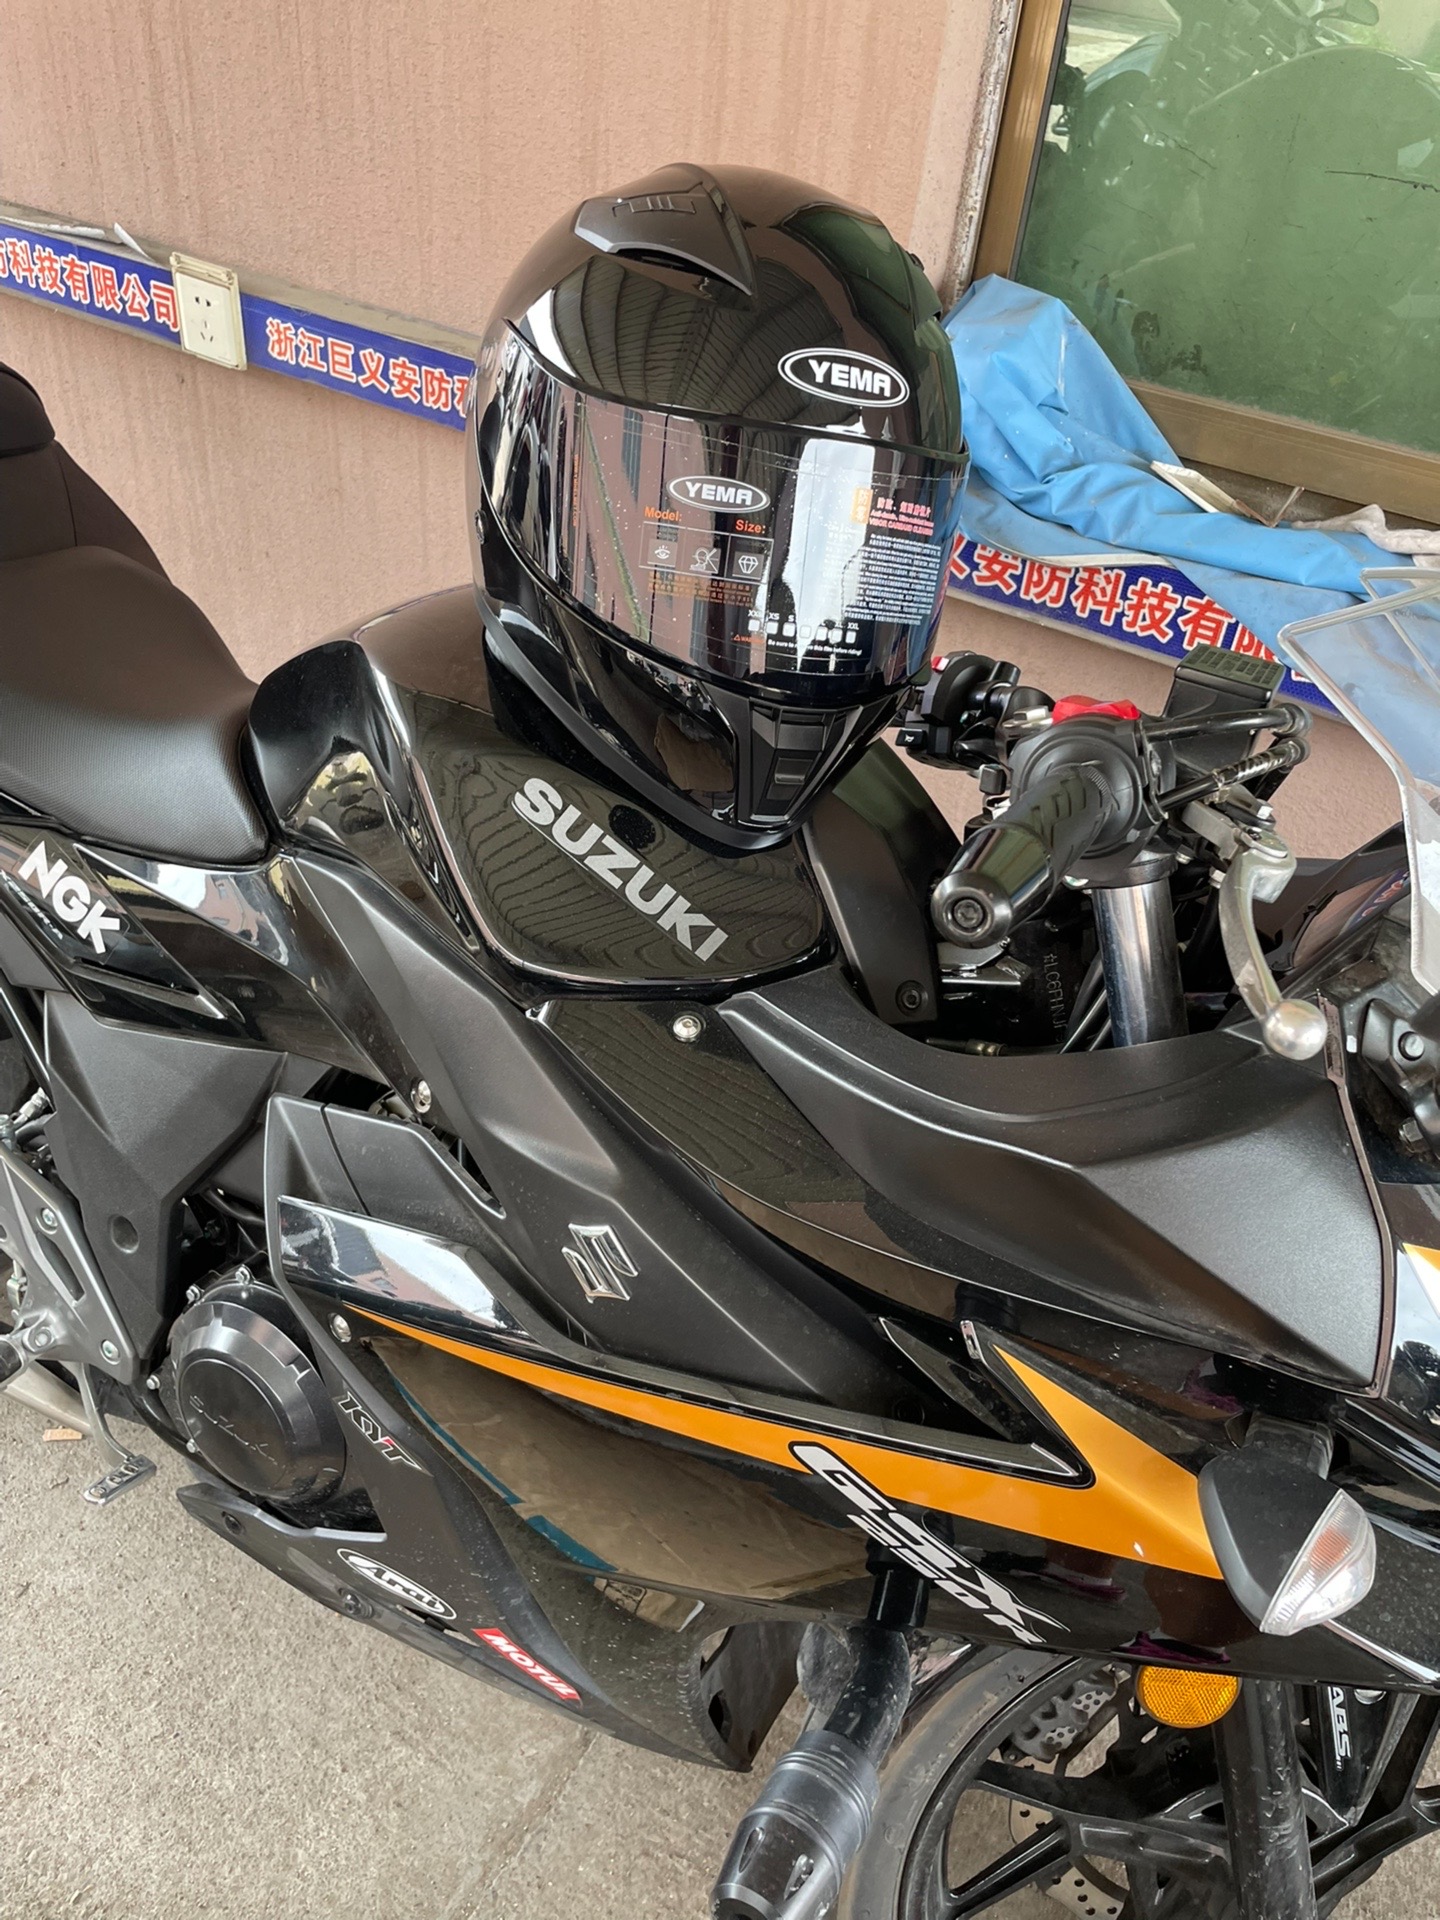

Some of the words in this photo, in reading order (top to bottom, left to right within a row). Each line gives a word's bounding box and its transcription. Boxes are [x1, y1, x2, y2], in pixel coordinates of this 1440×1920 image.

[807, 358, 893, 398] YEMA
[644, 506, 682, 522] Model:
[685, 481, 753, 506] YEMA
[735, 519, 766, 534] Size:
[514, 777, 729, 962] SUZUKI
[18, 840, 120, 954] NGK
[482, 1632, 578, 1700] MOTUL
[1328, 1686, 1351, 1758] ABS
